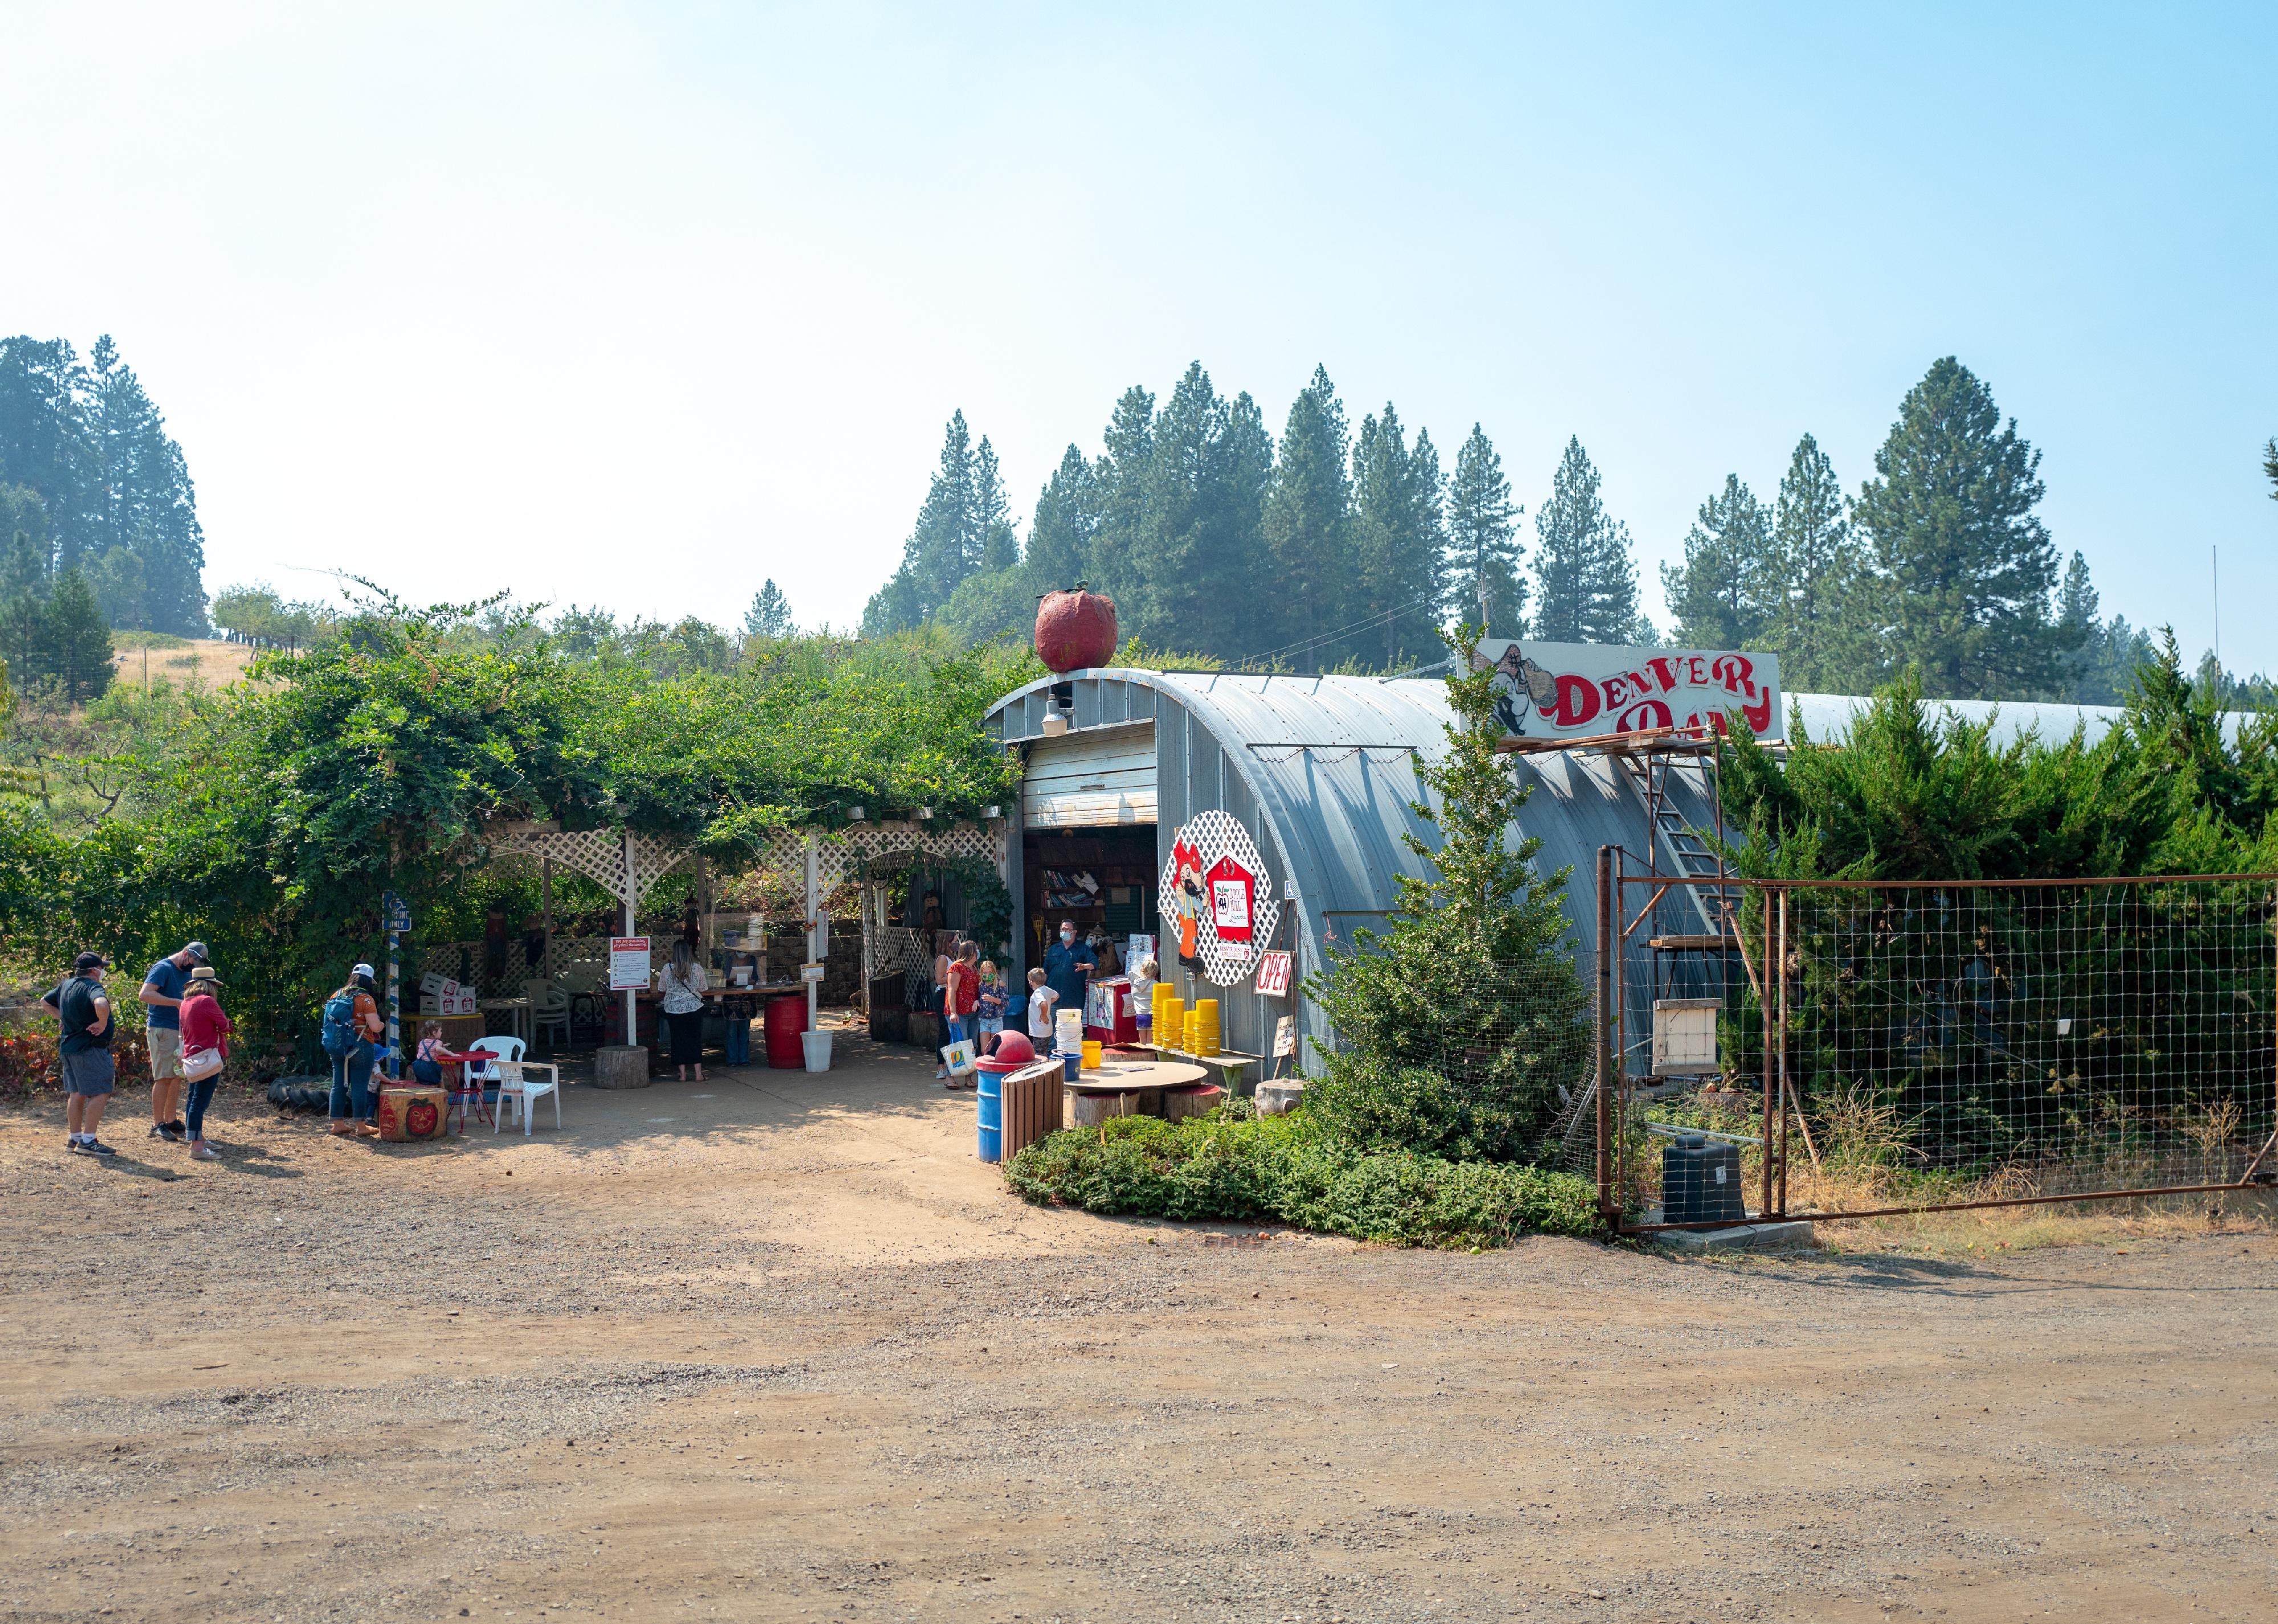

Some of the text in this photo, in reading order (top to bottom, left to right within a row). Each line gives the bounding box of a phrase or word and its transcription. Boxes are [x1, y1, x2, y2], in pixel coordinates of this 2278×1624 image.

[1230, 888, 1245, 899] APPLE
[1230, 900, 1241, 911] HILL
[1258, 954, 1291, 990] OPEN
